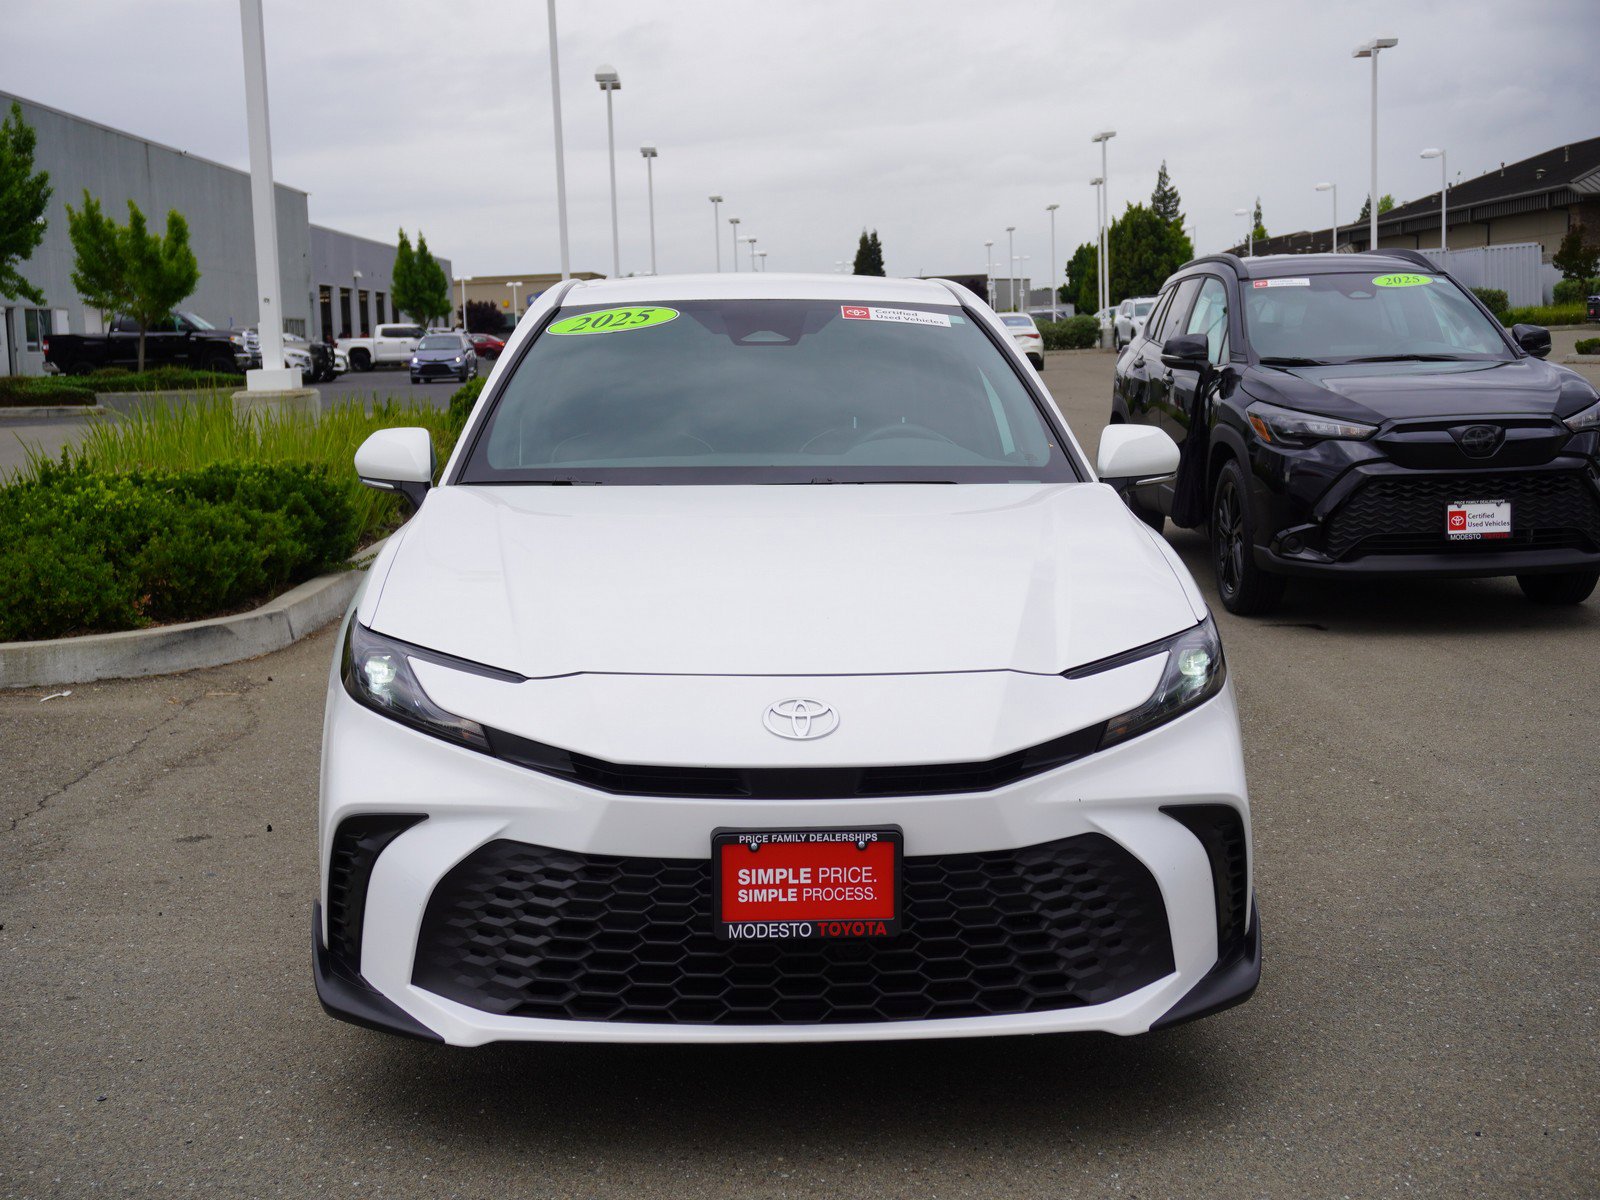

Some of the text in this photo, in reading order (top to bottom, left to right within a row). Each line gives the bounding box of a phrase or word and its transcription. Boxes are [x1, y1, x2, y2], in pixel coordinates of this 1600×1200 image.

[1386, 276, 1420, 286] 2025
[875, 309, 918, 317] Certified
[567, 309, 655, 332] 2025
[903, 316, 944, 325] Vehicles
[739, 833, 878, 844] PRICE FAMILY DEALERSHIPS
[738, 866, 877, 885] SIMPLE PRICE.
[738, 887, 877, 903] SIMPLE PROCESS.
[728, 921, 887, 939] MODESTO TOYOTA
